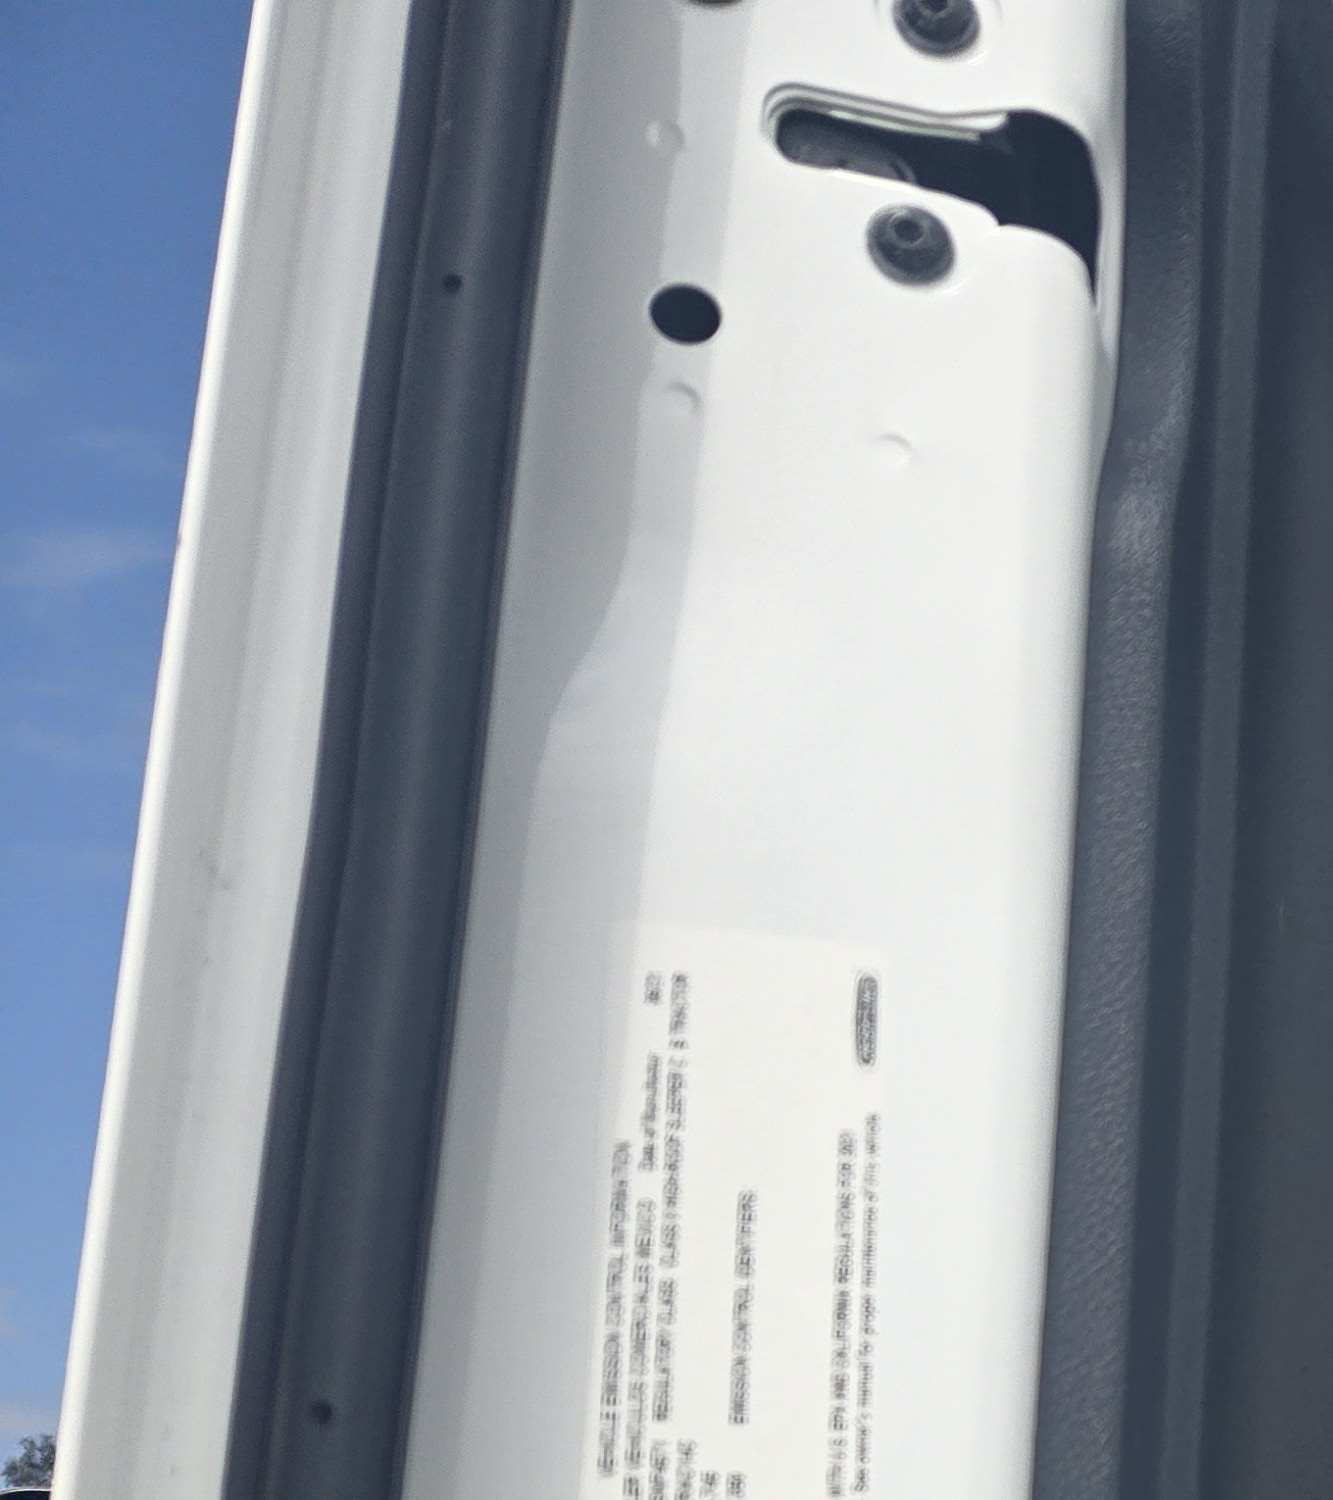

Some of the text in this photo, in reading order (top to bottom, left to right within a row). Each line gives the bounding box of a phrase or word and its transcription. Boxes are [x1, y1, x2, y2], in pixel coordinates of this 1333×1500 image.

[667, 1070, 684, 1133] SLEEPER
[838, 1161, 854, 1190] FOR
[863, 1161, 879, 1188] this
[863, 1189, 878, 1205] of
[660, 1224, 679, 1269] CLASS
[835, 1192, 853, 1287] REGULATIONS
[862, 1206, 876, 1289] maintenance
[598, 1140, 629, 1478] VEHICLE EMISSION CONTROL INFORMATION
[733, 1285, 752, 1355] CONTROL
[833, 1289, 849, 1370] CALIFORNIA
[861, 1294, 874, 1336] proper
[857, 1339, 873, 1361] for
[653, 1328, 671, 1422] REGULATORY
[730, 1356, 748, 1425] EMISSION
[832, 1371, 848, 1400] AND
[858, 1361, 872, 1408] manual
[829, 1403, 847, 1432] EPA
[857, 1412, 869, 1466] owner's
[827, 1462, 843, 1499] WITH
[852, 1466, 868, 1493] See
